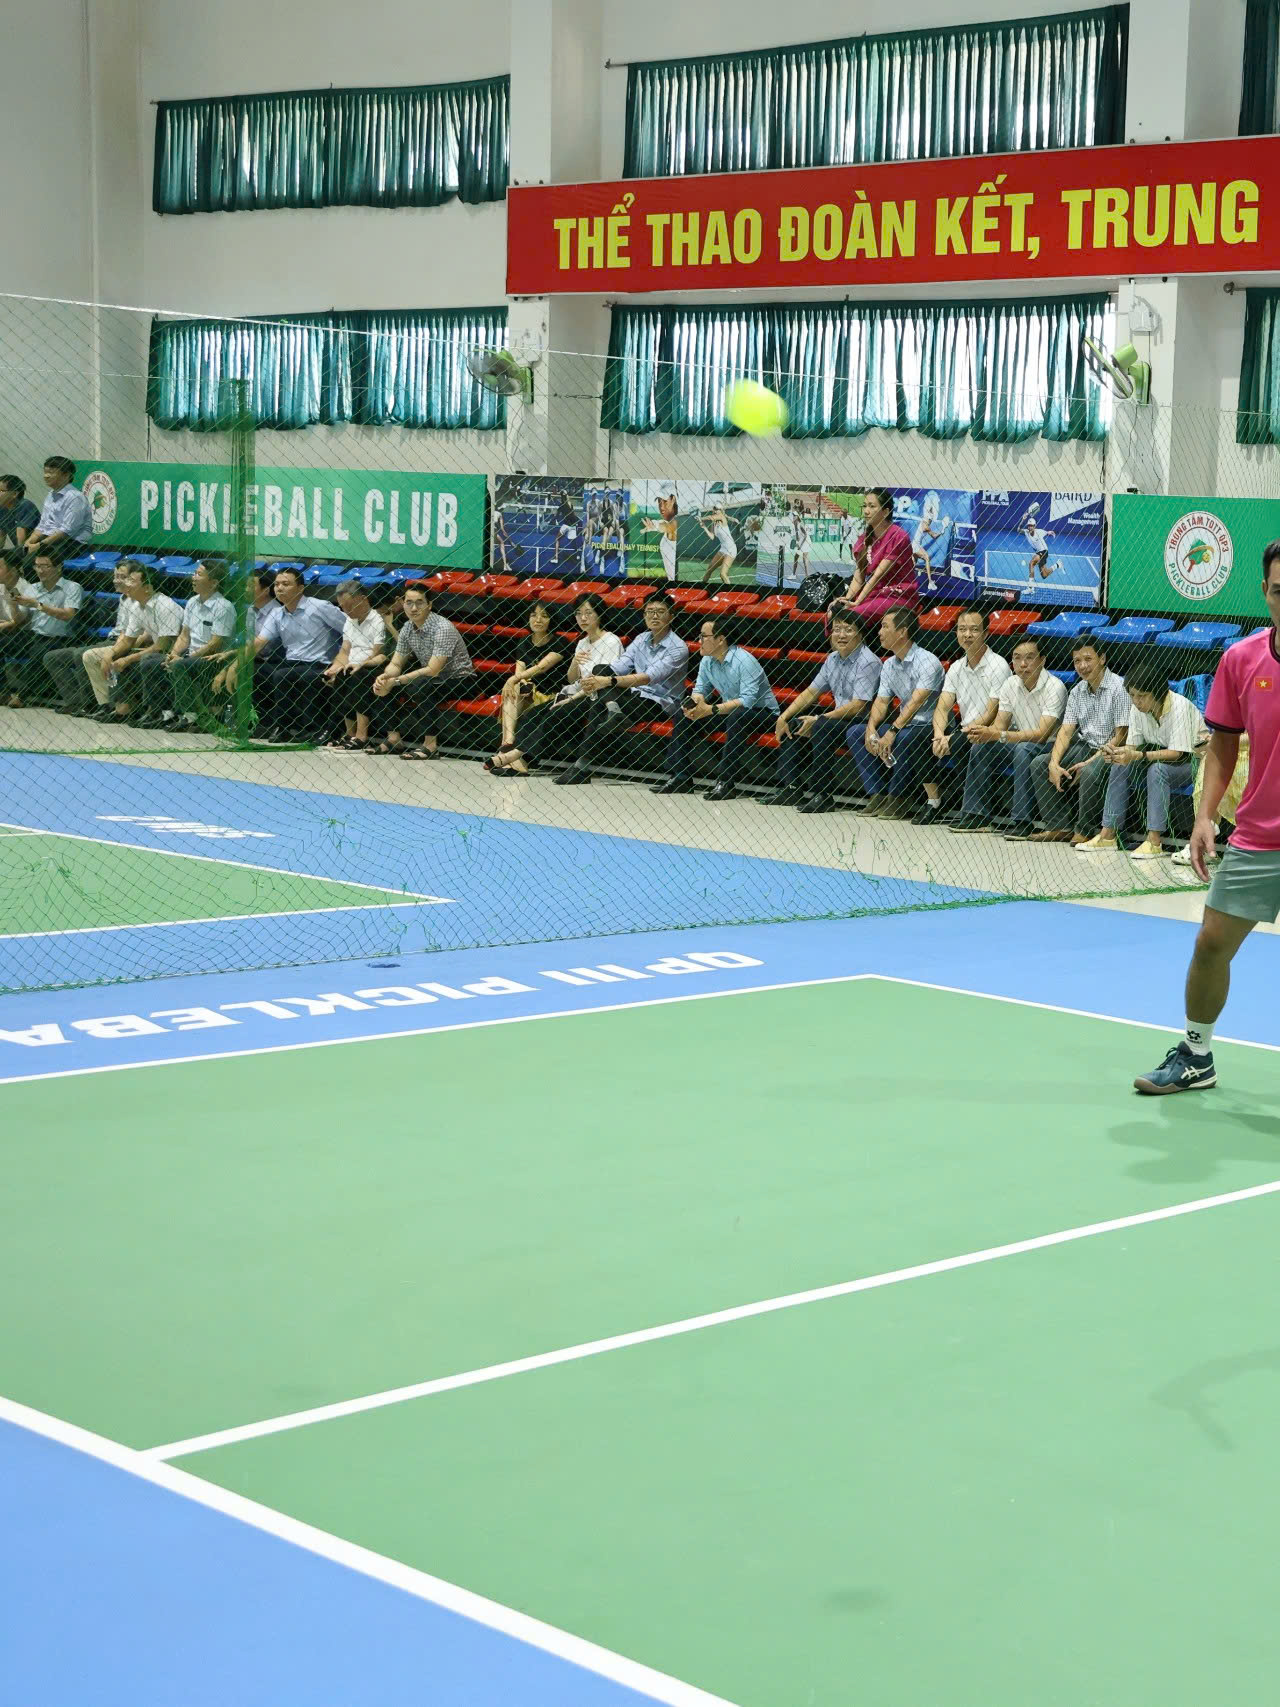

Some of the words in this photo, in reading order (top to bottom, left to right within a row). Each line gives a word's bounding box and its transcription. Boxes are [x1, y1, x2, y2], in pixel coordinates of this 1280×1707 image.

[554, 193, 634, 269] THỂ
[647, 209, 761, 266] THAO
[778, 191, 915, 261] ĐOÀN
[936, 175, 1039, 258] KẾT,
[1062, 180, 1258, 249] TRUNG
[140, 480, 350, 541] PICKLEBALL
[363, 488, 458, 548] CLUB
[1168, 522, 1188, 550] TRUNG
[1168, 562, 1211, 597] PICKLEBALL
[1211, 565, 1228, 590] CLUB
